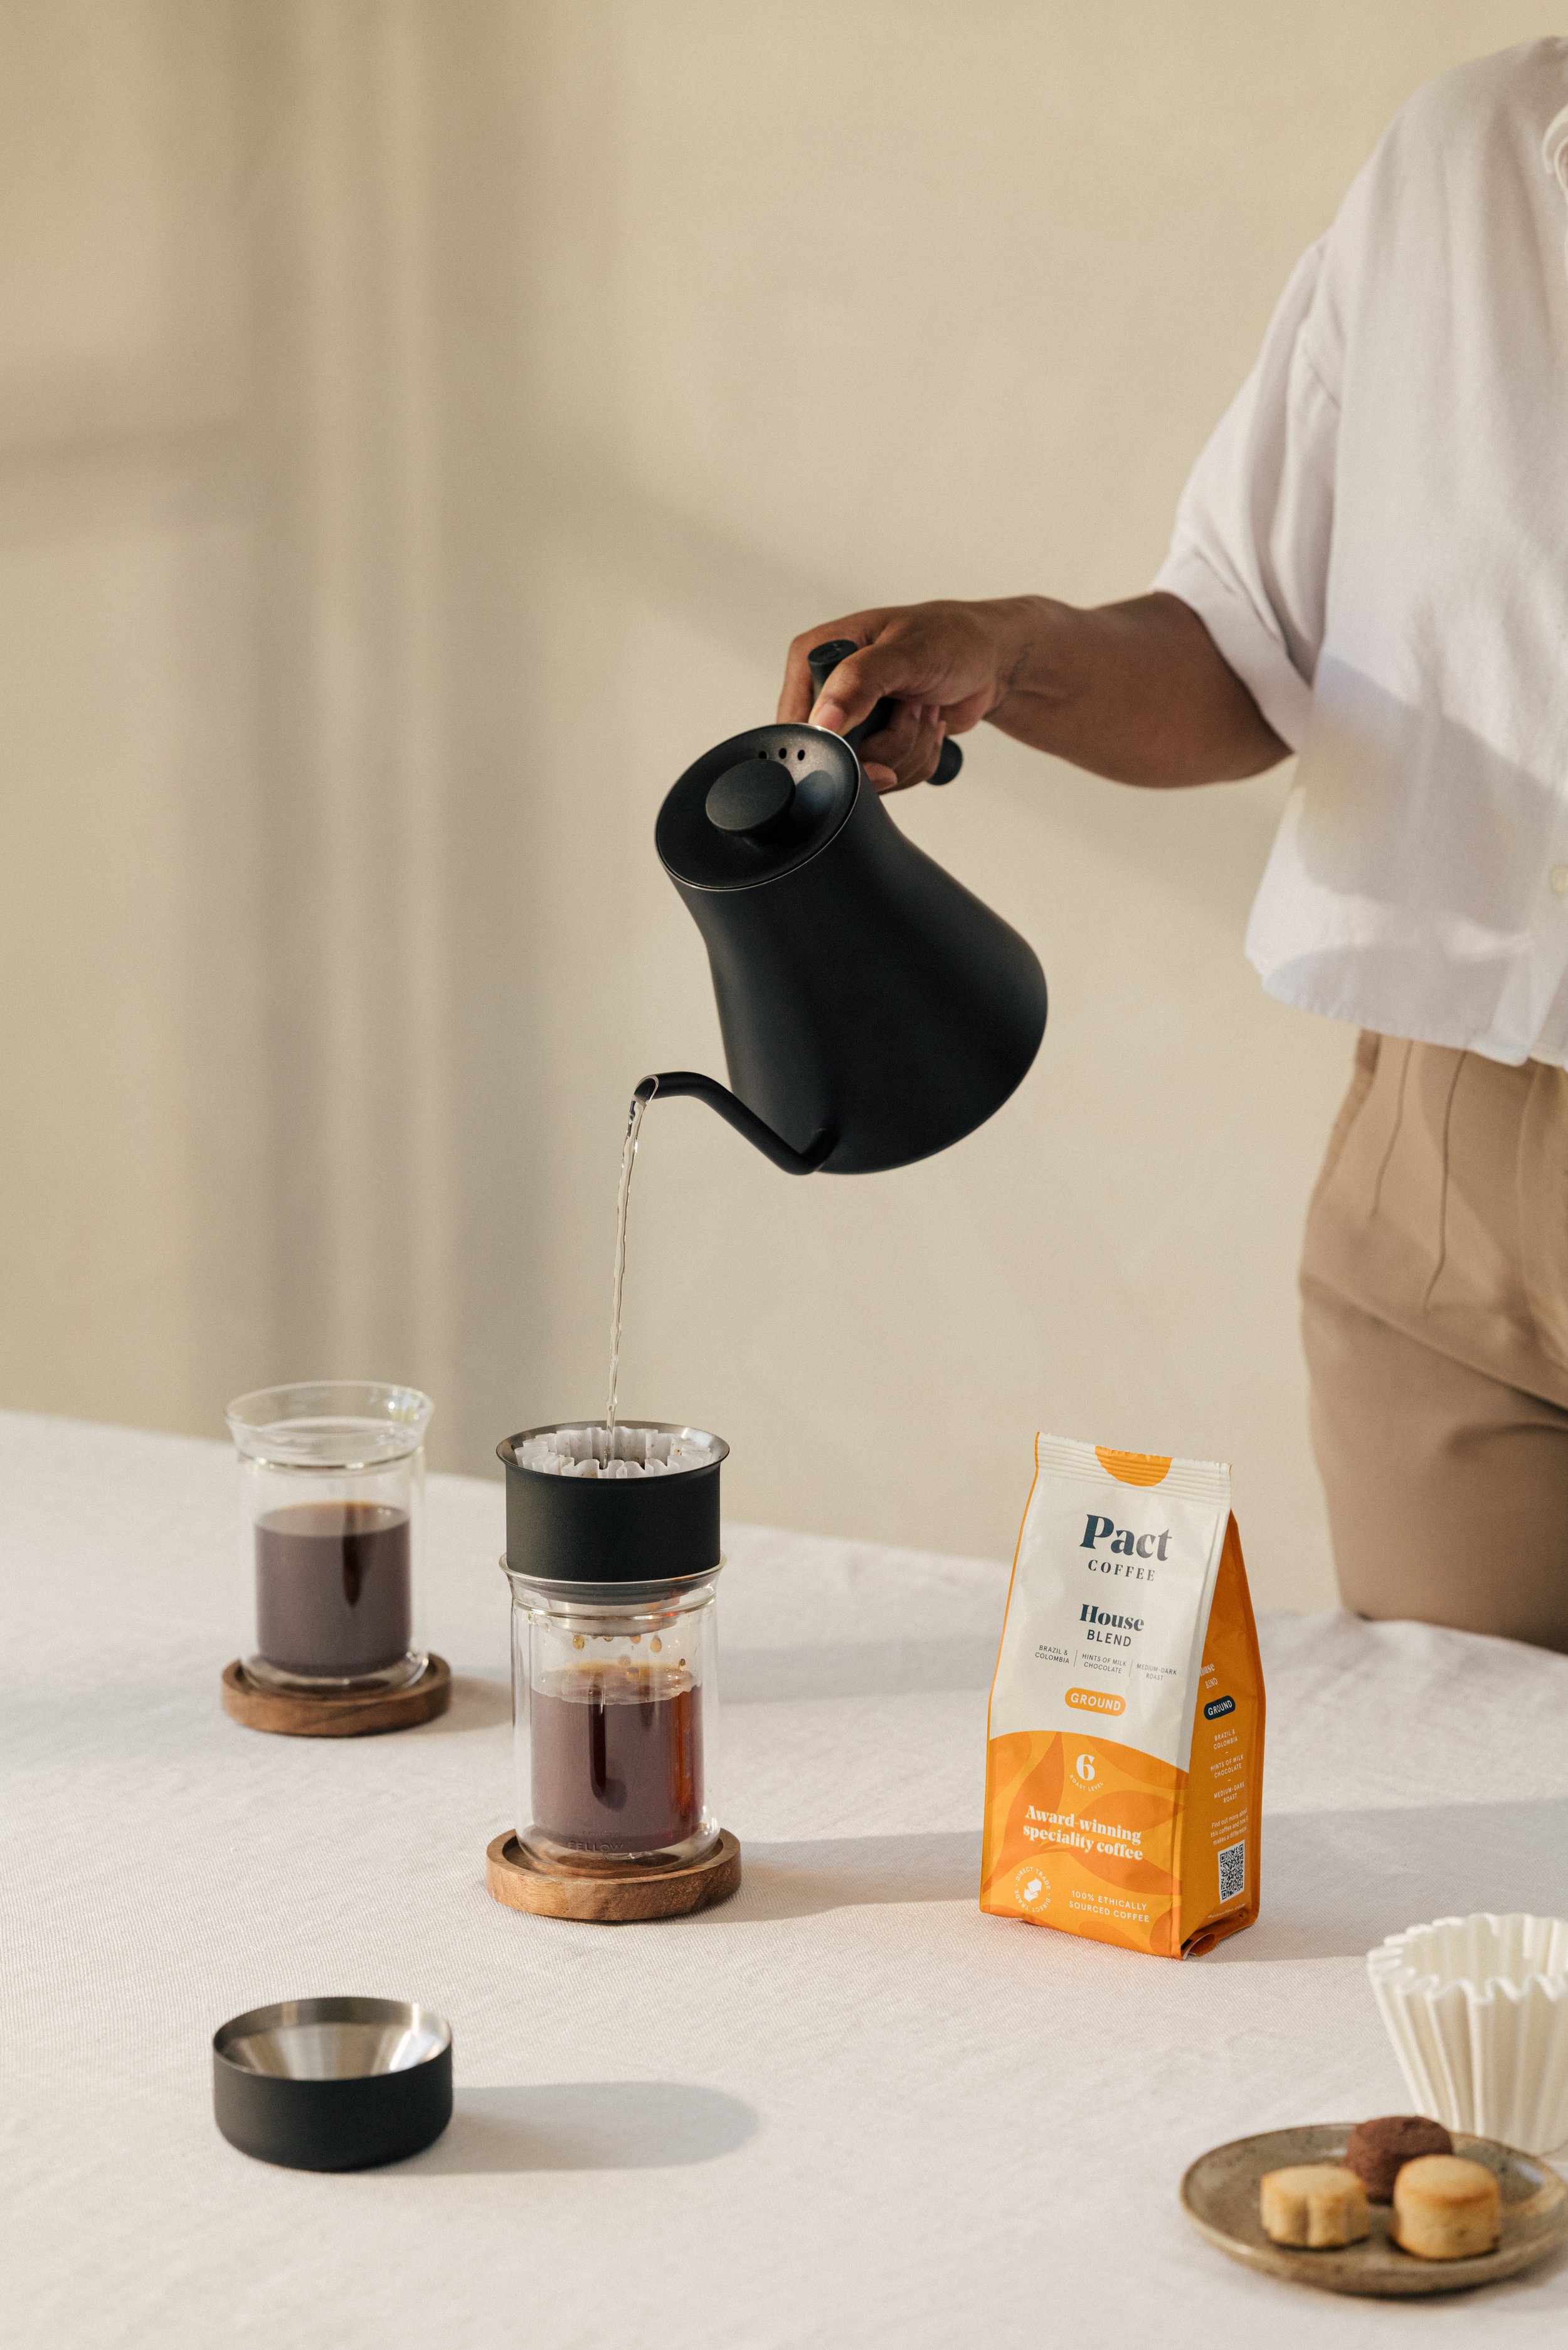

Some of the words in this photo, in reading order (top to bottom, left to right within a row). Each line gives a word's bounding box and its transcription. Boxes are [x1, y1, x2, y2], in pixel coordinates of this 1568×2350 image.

[1079, 1514, 1172, 1561] Pact
[1088, 1560, 1155, 1581] COFFEE
[1079, 1603, 1145, 1631] House
[1087, 1629, 1131, 1647] BLEND
[1039, 1645, 1062, 1654] BRAZIL
[1035, 1652, 1069, 1664] COLOMBIA
[1082, 1654, 1101, 1662] HINTS
[1084, 1662, 1122, 1673] CHOCOLATE
[1136, 1664, 1177, 1676] MEDIUM-DARK
[1200, 1663, 1216, 1676] ouse
[1205, 1677, 1218, 1689] BLEND
[1071, 1693, 1121, 1711] GROUND
[1208, 1700, 1232, 1715] GROUND
[1214, 1730, 1231, 1741] BRAZIL
[1214, 1736, 1238, 1750] COLOMBIA
[1076, 1754, 1095, 1781] 6
[1210, 1762, 1224, 1771] HINTS
[1233, 1754, 1244, 1762] MILK
[1214, 1763, 1242, 1778] CHOCOLATE
[1069, 1774, 1086, 1790] ROAST
[1088, 1782, 1104, 1792] LEVEL
[1214, 1782, 1245, 1799] MEDIUM-DARK
[1223, 1793, 1237, 1804] ROAST
[1025, 1805, 1142, 1846] Award-winning
[1212, 1821, 1221, 1829] Find
[1219, 1825, 1232, 1834] coffee
[568, 1841, 623, 1852] FELLOW
[1023, 1825, 1094, 1853] speciality
[1096, 1841, 1143, 1861] coffee
[1015, 1866, 1033, 1881] DIRECT
[1036, 1868, 1051, 1890] TRADE
[1014, 1890, 1029, 1911] TRADE
[1032, 1898, 1051, 1912] DIRECT
[1071, 1890, 1094, 1901] 100%
[1098, 1895, 1147, 1911] ETHICALLY
[1069, 1901, 1110, 1915] SOURCED
[1113, 1910, 1149, 1922] COFFEE
